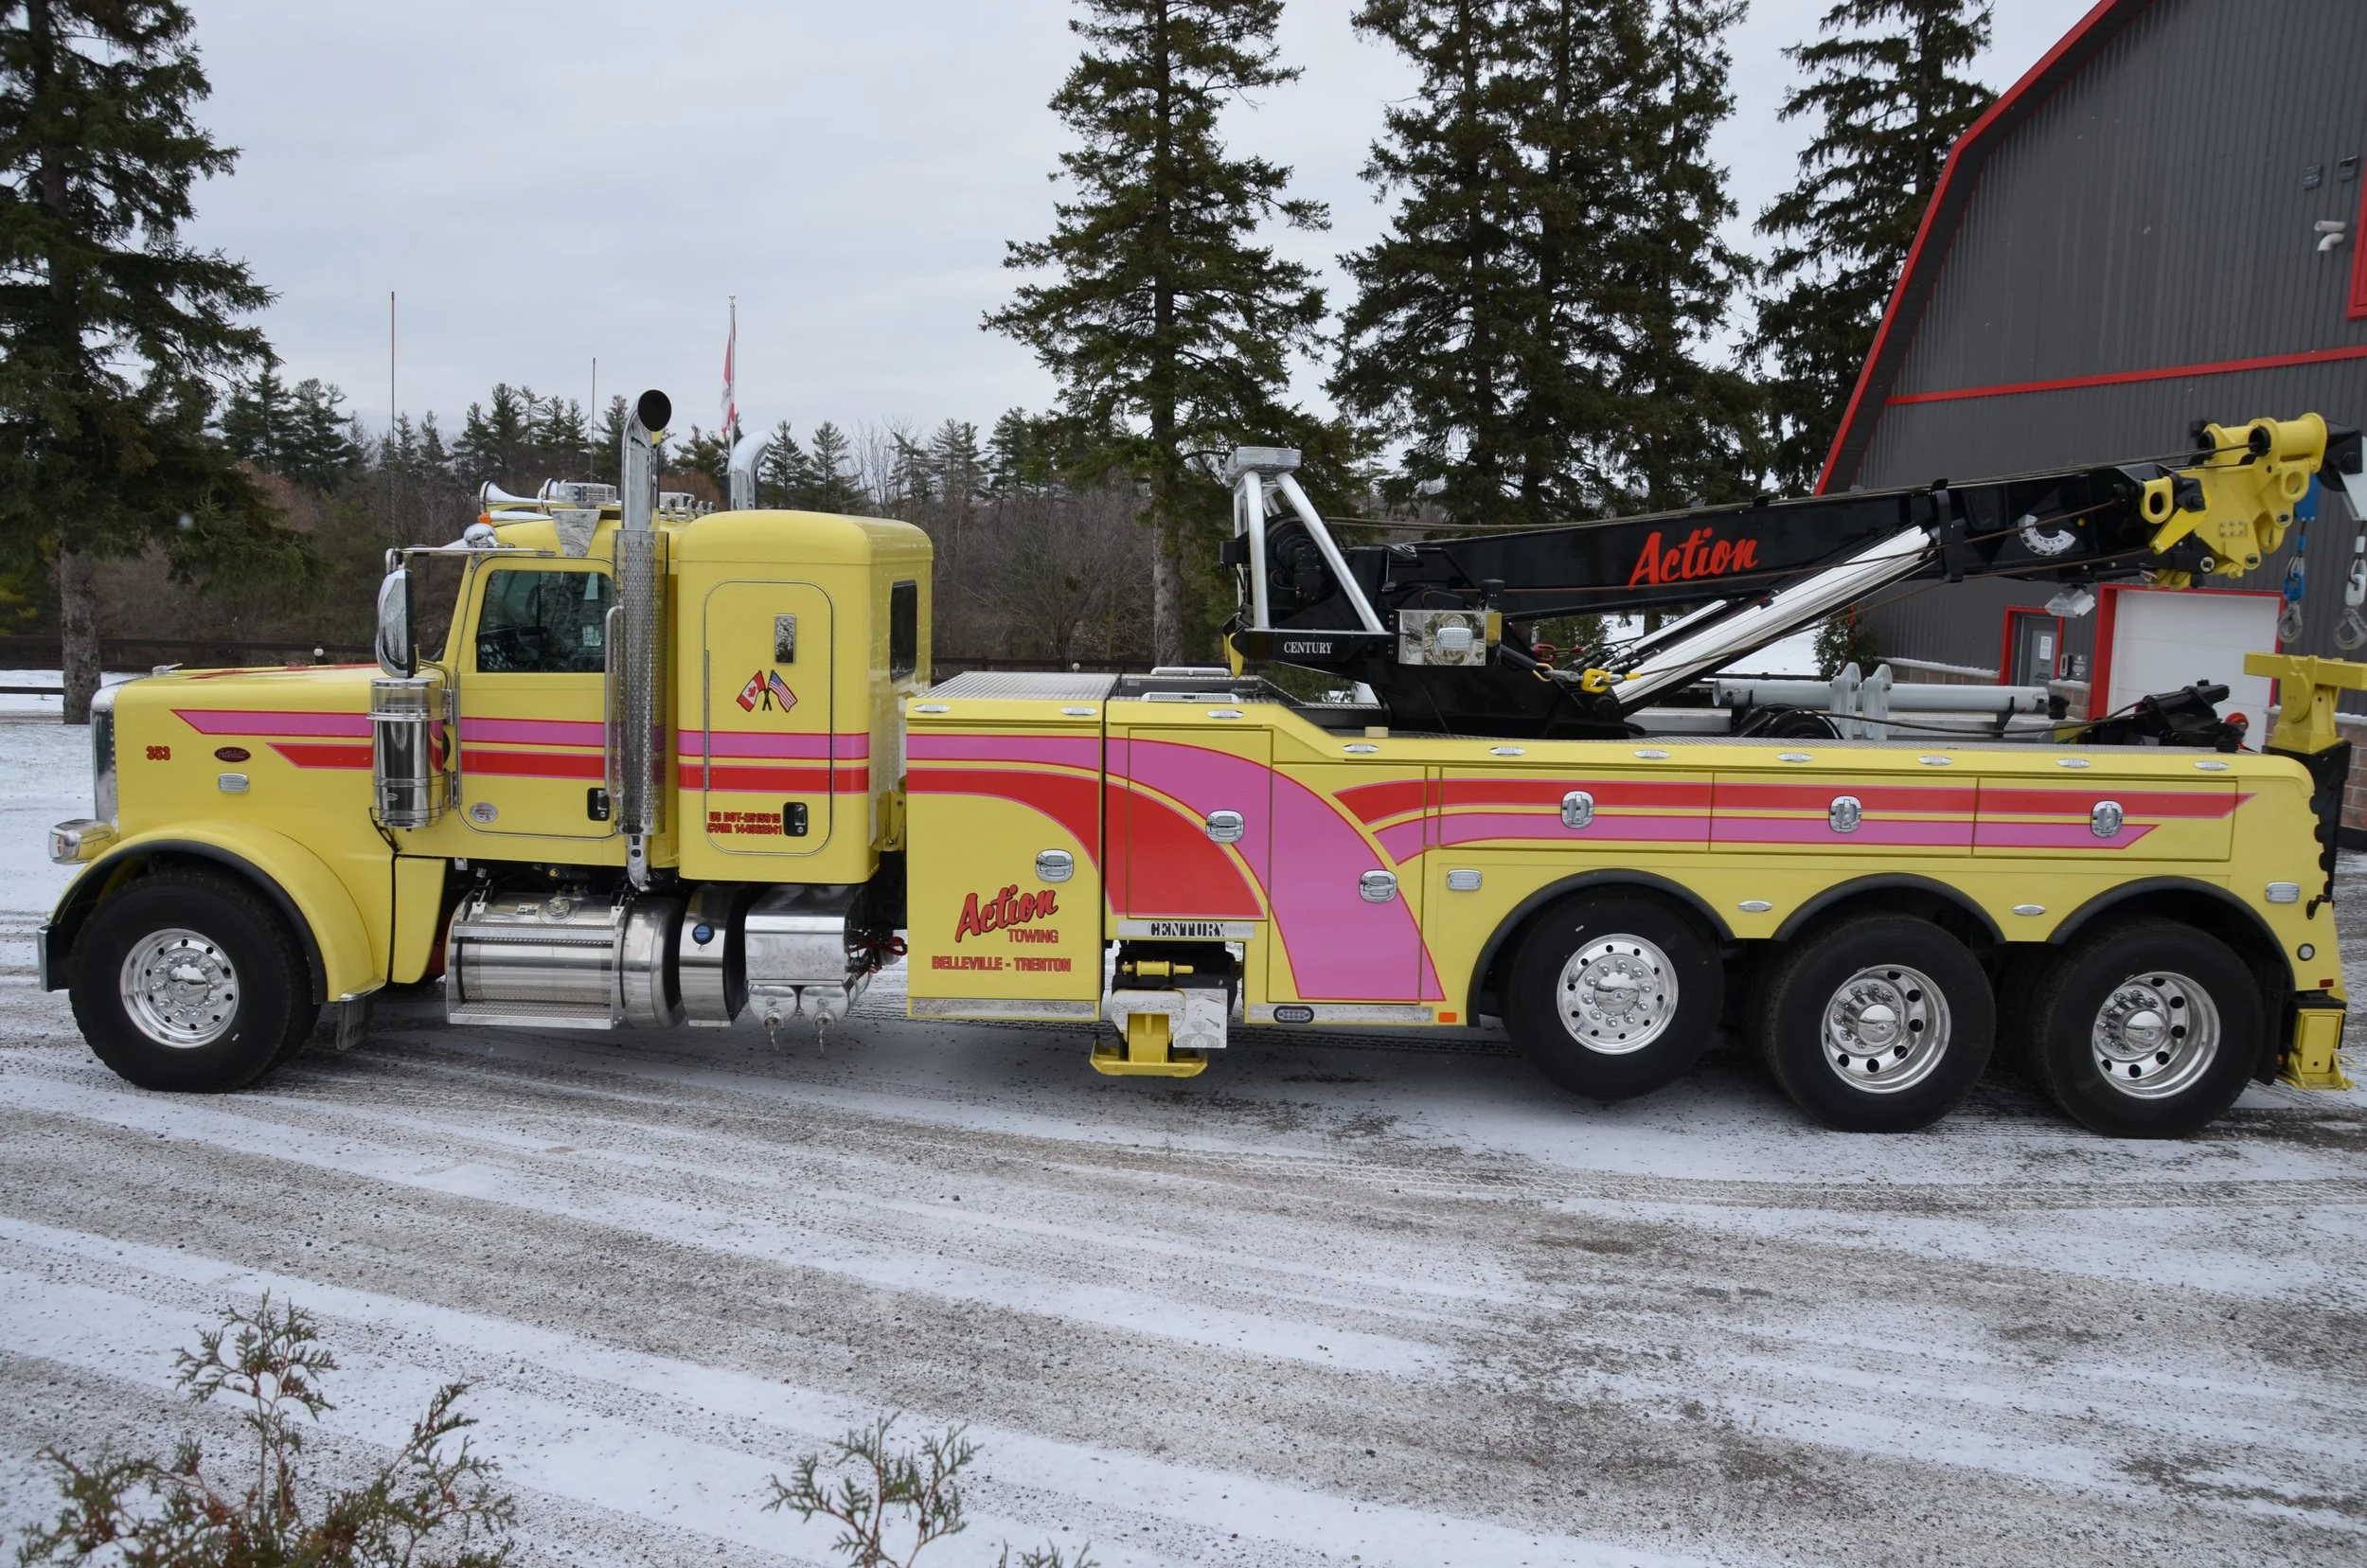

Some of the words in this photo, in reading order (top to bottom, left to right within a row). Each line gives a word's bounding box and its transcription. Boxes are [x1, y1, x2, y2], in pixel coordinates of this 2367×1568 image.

[1628, 526, 1758, 590] Action
[1284, 641, 1333, 654] CENTURY
[708, 811, 721, 822] US
[954, 883, 1059, 943] Action
[1006, 928, 1059, 944] TOWING
[1150, 921, 1225, 937] CENTURY
[931, 954, 1004, 971] BELLEVILLE
[1013, 956, 1072, 972] TRENTON
